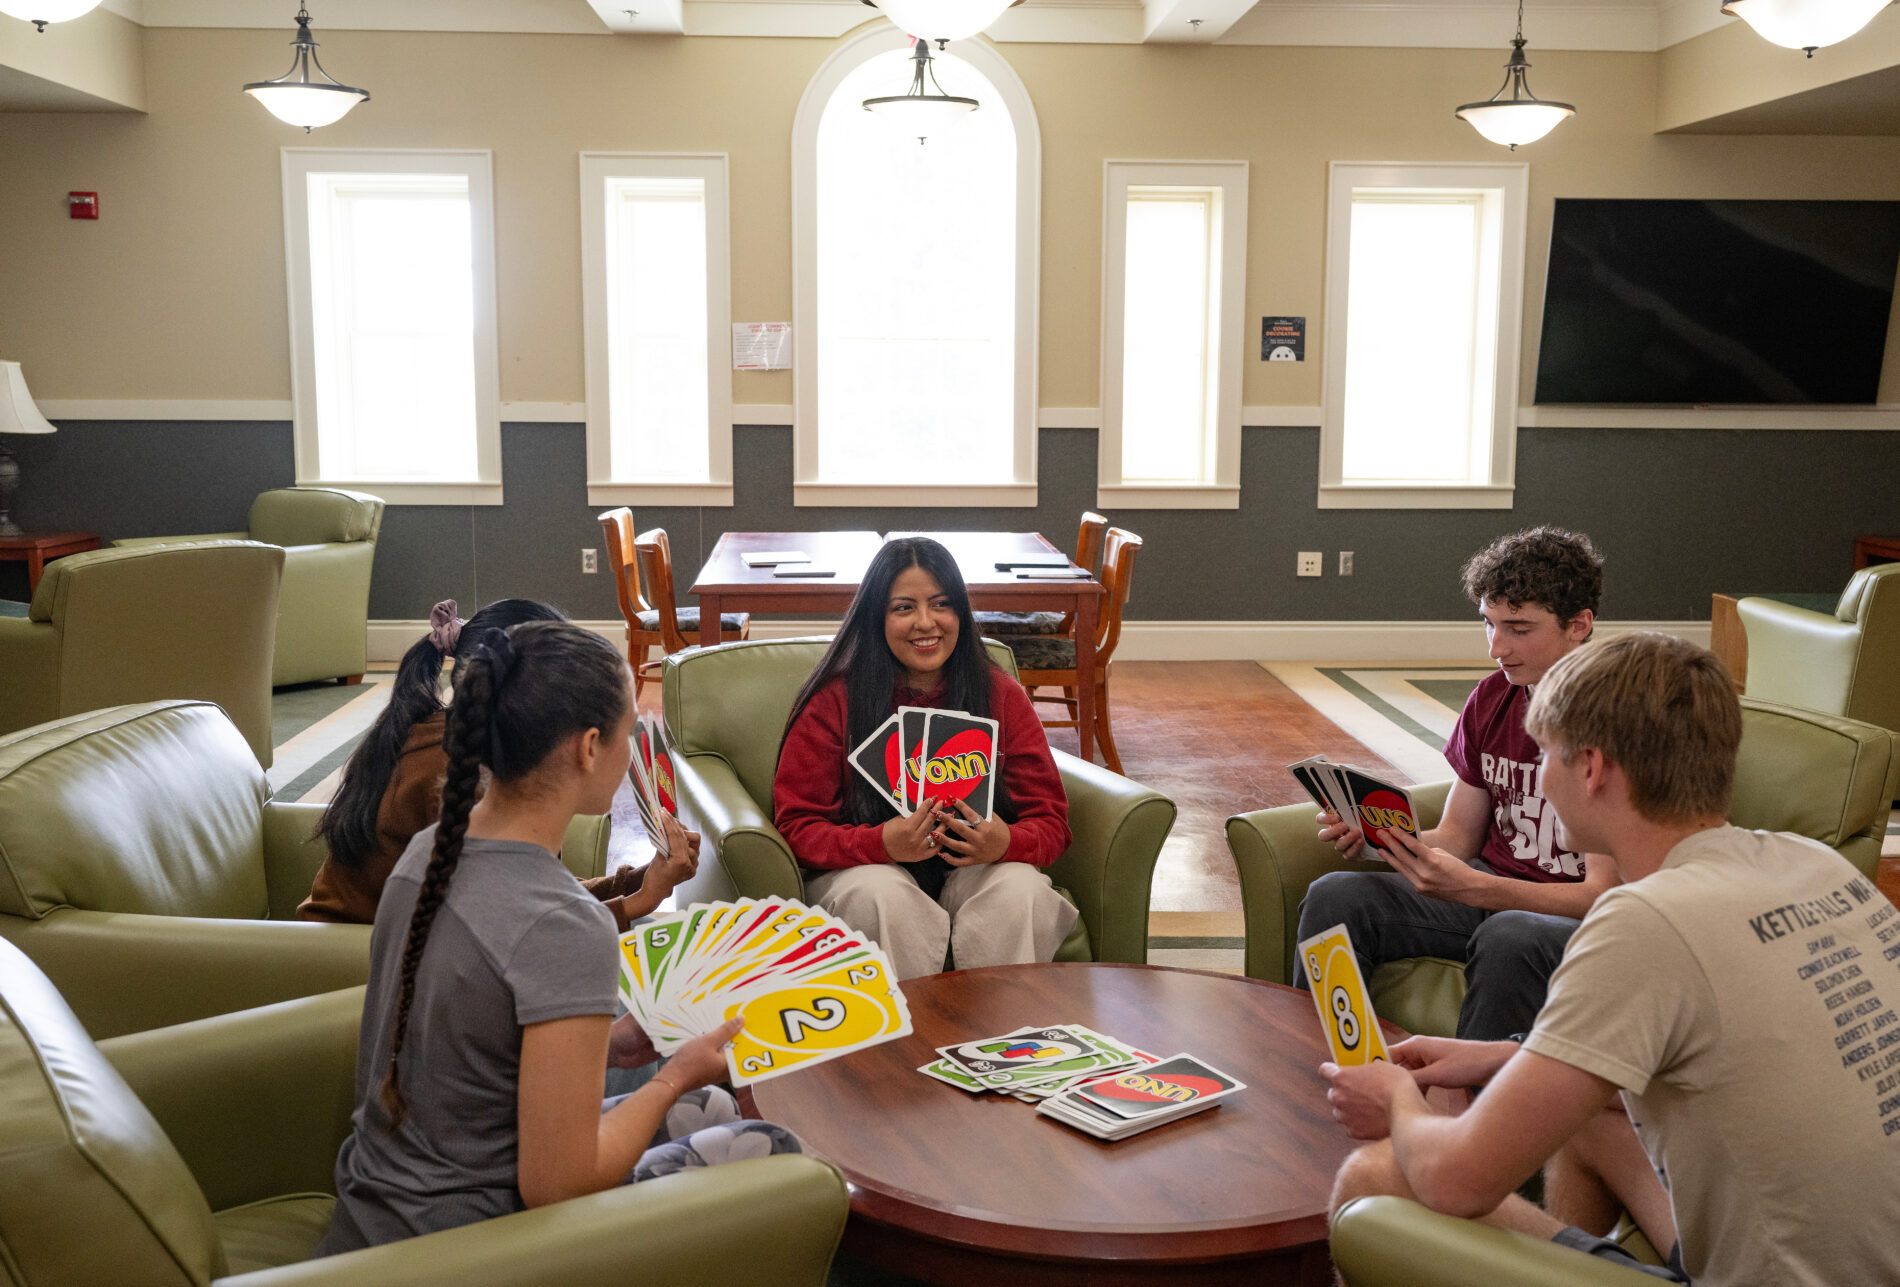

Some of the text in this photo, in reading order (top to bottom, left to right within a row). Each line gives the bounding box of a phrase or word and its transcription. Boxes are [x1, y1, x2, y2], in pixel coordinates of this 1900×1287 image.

[925, 750, 992, 784] UNO
[1356, 804, 1416, 834] UNO
[650, 928, 671, 948] 5
[848, 965, 879, 985] 2
[1308, 952, 1322, 983] 8
[779, 997, 847, 1044] 2
[1331, 985, 1361, 1051] 8
[1834, 996, 1883, 1028] NOAH HOLDEN
[1834, 1009, 1898, 1051] GARRETT JARVIS
[742, 1051, 775, 1072] 2
[1841, 1042, 1876, 1070] ANDERS
[1857, 1060, 1882, 1082] KYLE
[1876, 1074, 1897, 1096] JOJO
[1115, 1074, 1200, 1101] UNO
